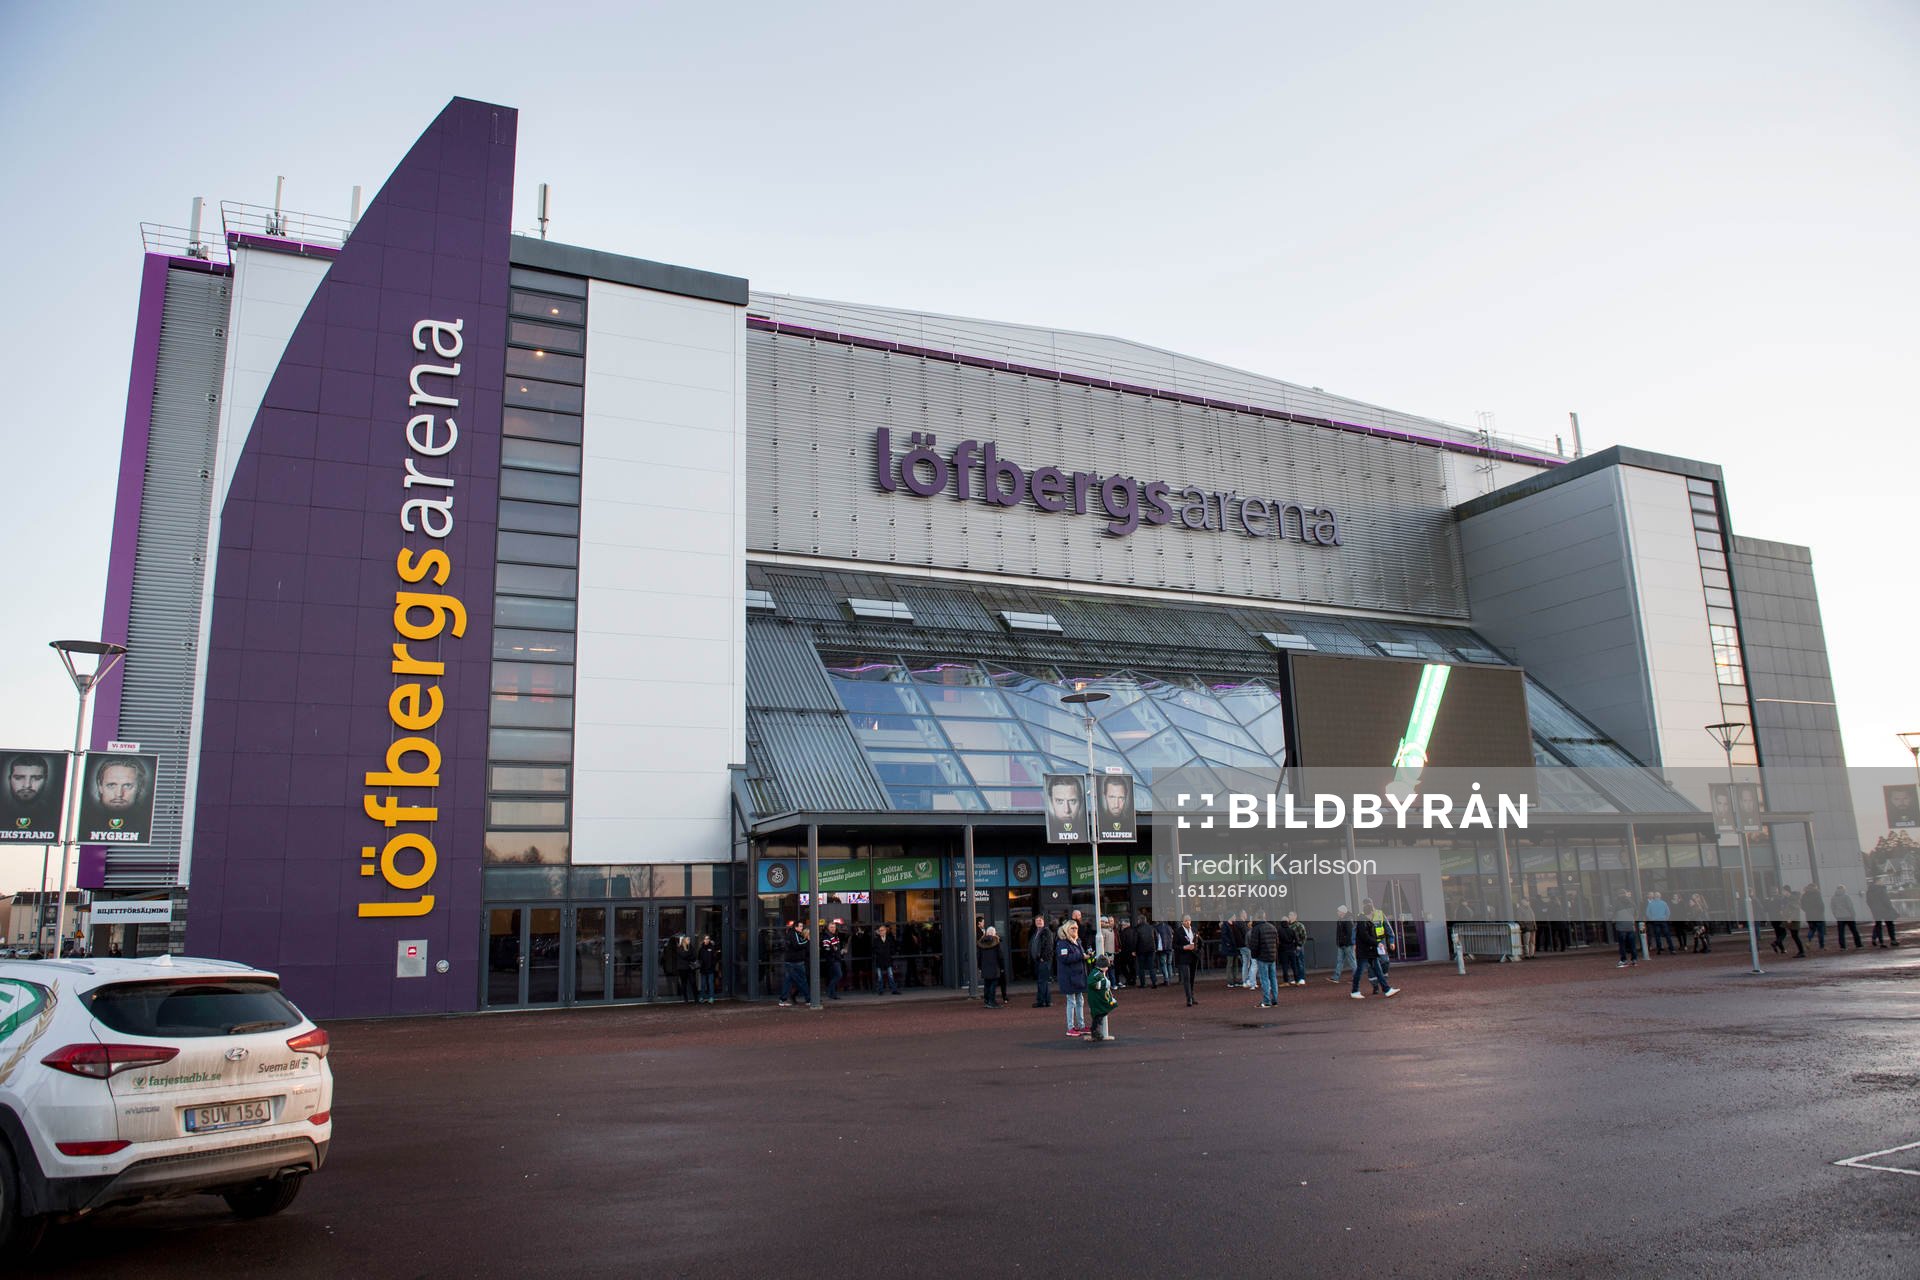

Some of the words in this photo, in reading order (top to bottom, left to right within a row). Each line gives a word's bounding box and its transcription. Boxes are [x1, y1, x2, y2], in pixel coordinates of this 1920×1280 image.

[876, 426, 1344, 547] löfbergsarena
[358, 318, 467, 918] löfbergsarena
[0, 831, 55, 839] IKSTRAND
[90, 831, 139, 841] NYGREN
[1058, 832, 1079, 840] RYNO
[900, 871, 913, 880] FBK
[97, 907, 169, 915] BILJETTFÖRSÄLJNING
[148, 1073, 222, 1087] farjestadbk.se
[201, 1107, 231, 1125] SUW
[237, 1103, 264, 1121] 156
